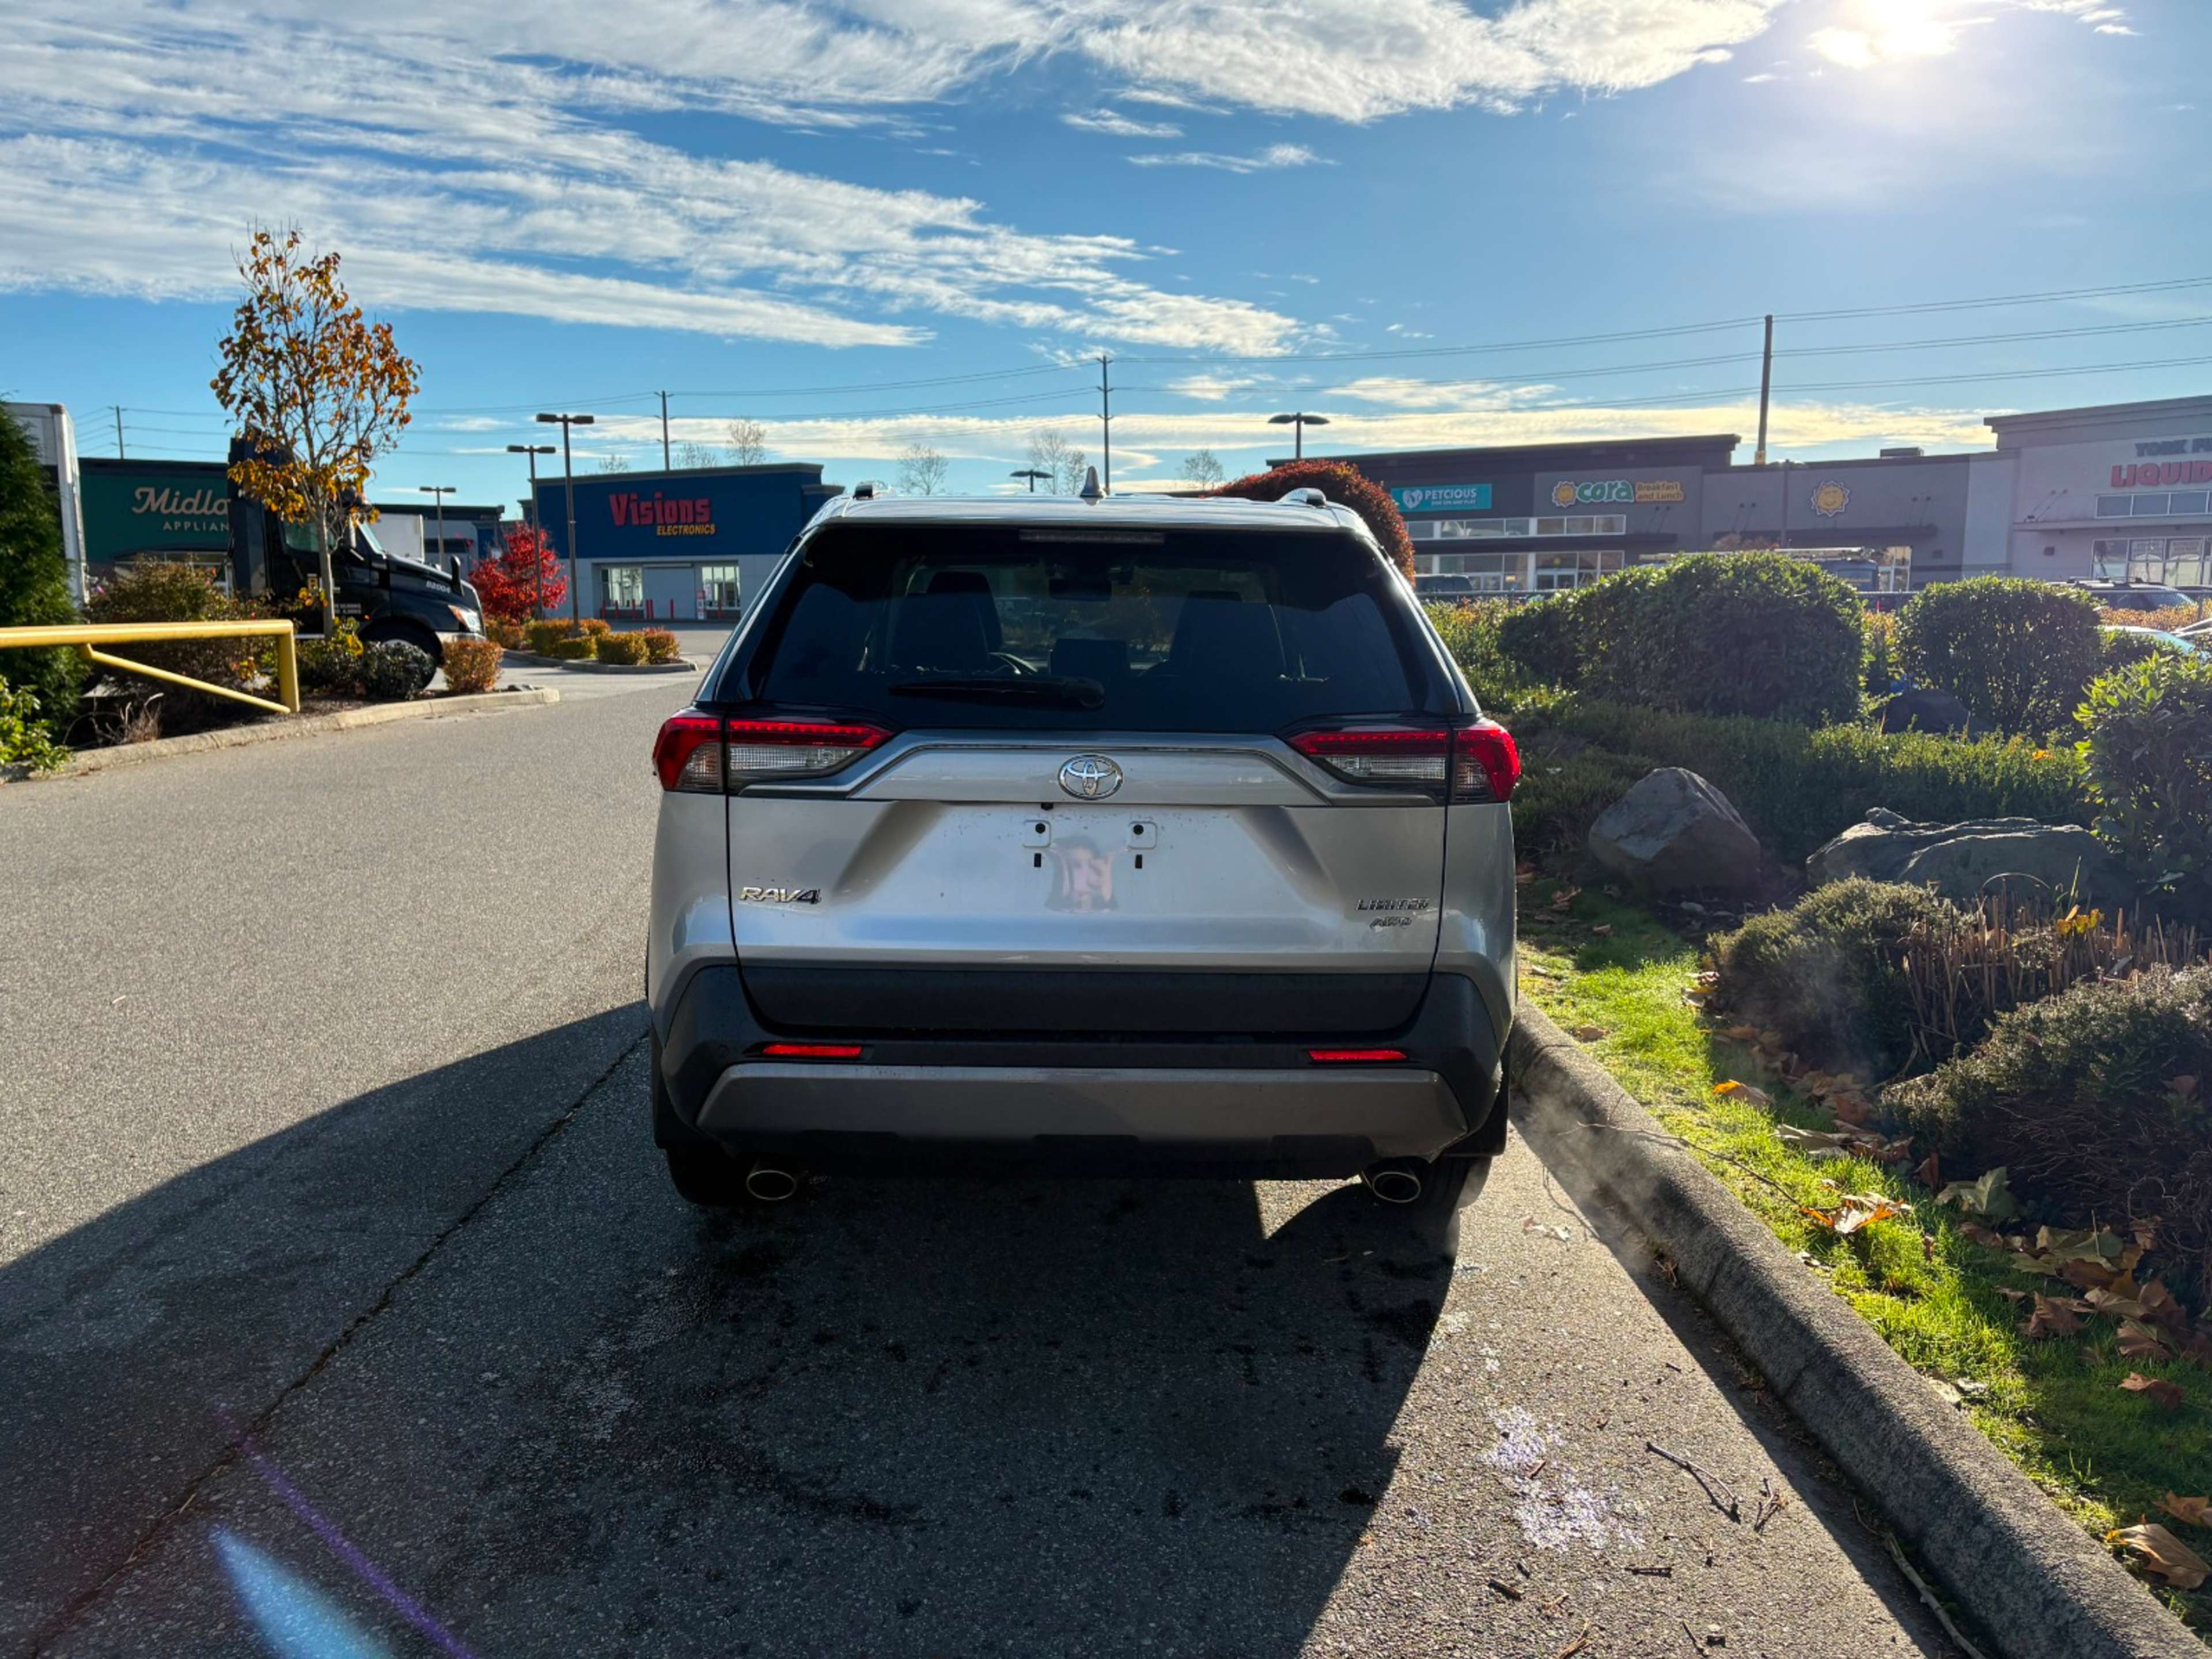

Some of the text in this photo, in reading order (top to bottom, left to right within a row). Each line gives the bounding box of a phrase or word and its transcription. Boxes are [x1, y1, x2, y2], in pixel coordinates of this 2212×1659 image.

[2111, 460, 2212, 487] LIQUID
[1577, 480, 1634, 503] cora
[1638, 482, 1679, 491] Breakfast
[1425, 488, 1478, 500] PETCIOUS
[1638, 491, 1683, 499] and Lunch
[609, 491, 711, 526] Visions
[656, 524, 715, 536] ELECTRONICS
[740, 887, 821, 904] RAV4
[1355, 898, 1429, 910] LIMITED
